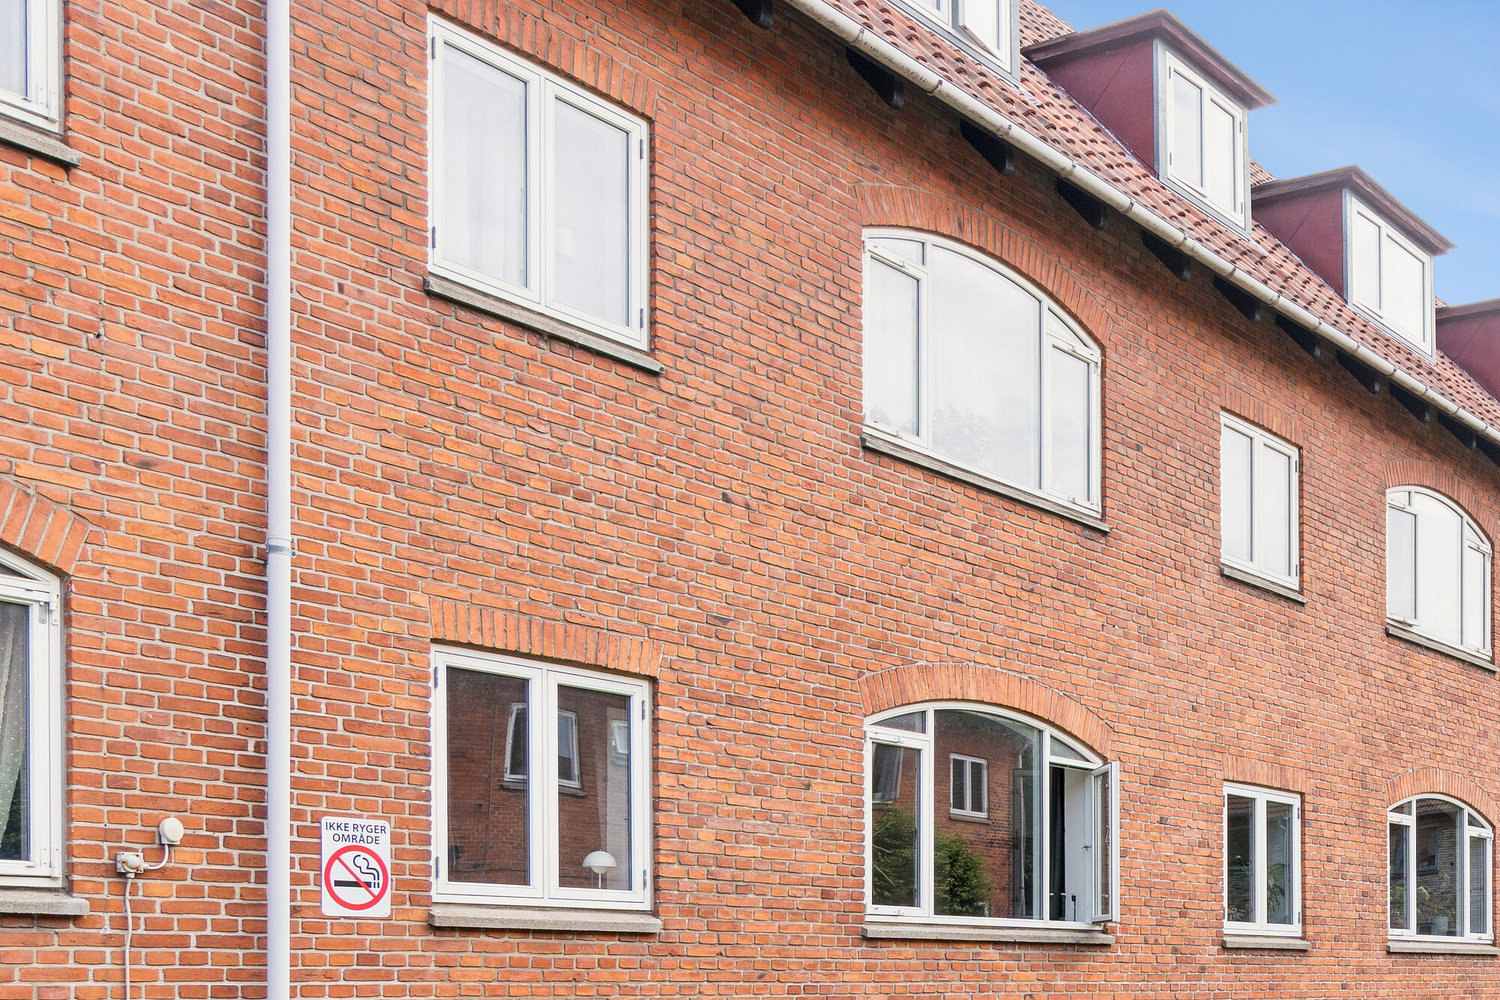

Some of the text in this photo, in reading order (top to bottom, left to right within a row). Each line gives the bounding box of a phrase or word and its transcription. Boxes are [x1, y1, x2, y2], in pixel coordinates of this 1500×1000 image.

[325, 822, 387, 834] IKKE RYGER
[332, 833, 380, 845] OMRÅDE
